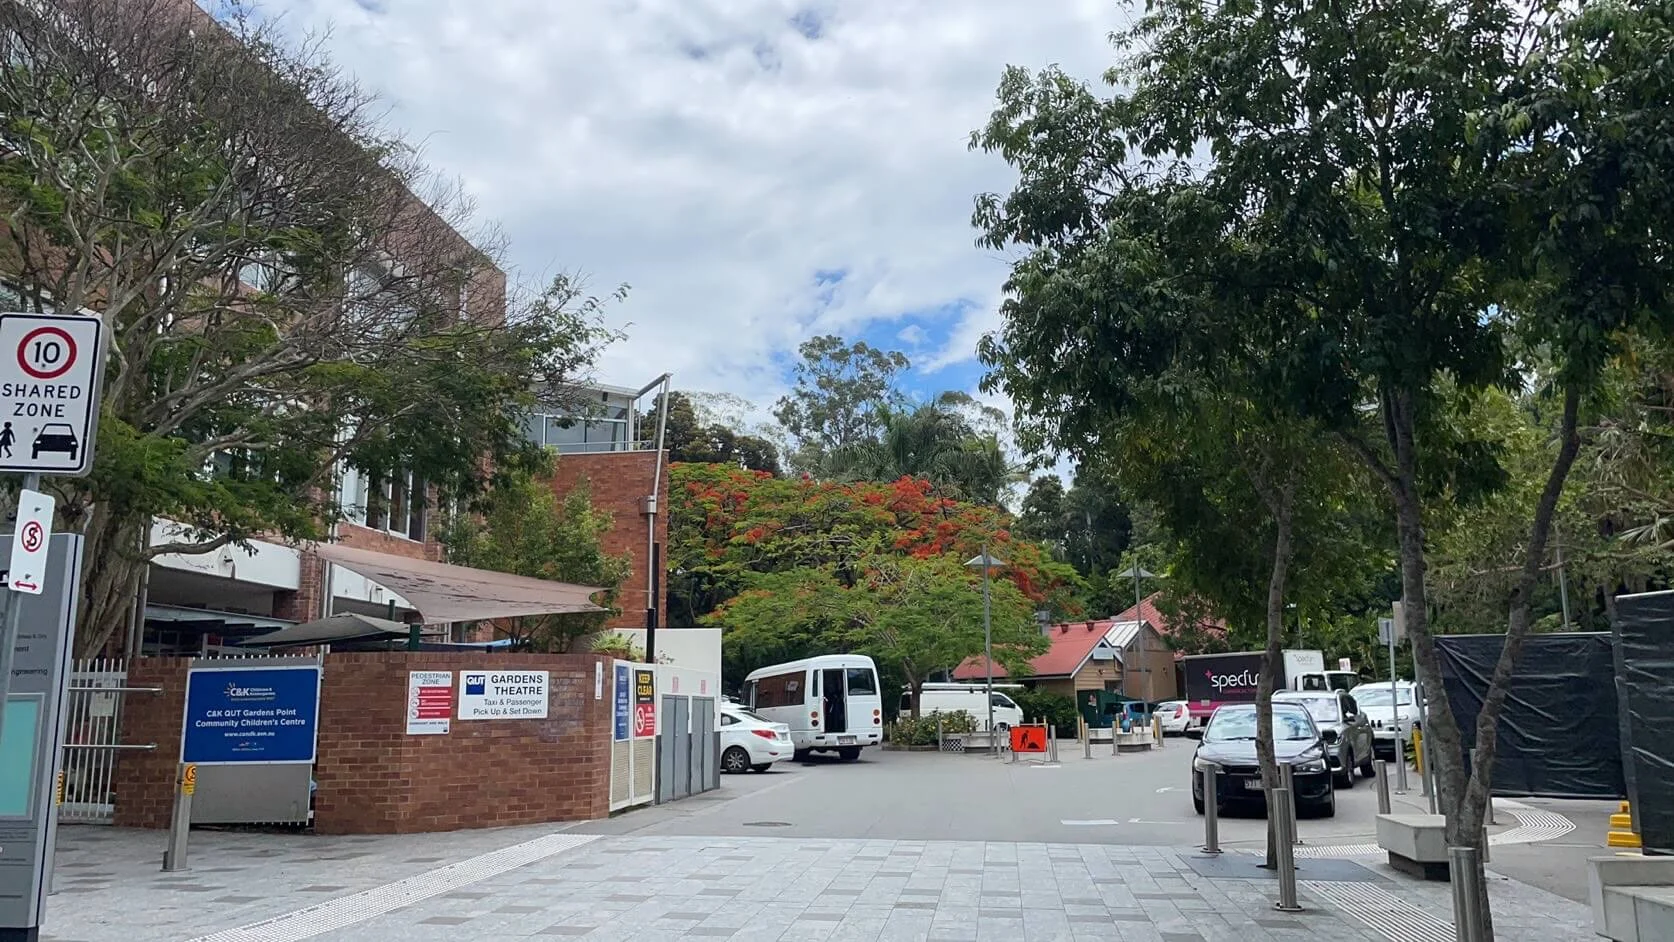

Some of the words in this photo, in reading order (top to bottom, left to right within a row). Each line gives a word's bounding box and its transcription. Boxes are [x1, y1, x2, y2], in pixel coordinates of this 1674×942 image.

[34, 341, 61, 364] 10
[2, 383, 81, 399] SHARED
[13, 402, 65, 417] ZONE
[467, 676, 485, 686] QUT
[491, 674, 543, 684] GARDENS
[638, 673, 650, 684] KEEP
[1211, 669, 1260, 693] specfur
[494, 686, 543, 695] THEATRE
[637, 685, 653, 696] CLEAR
[506, 698, 542, 707] Passenger
[206, 710, 223, 718] C&K
[224, 709, 241, 717] QUT
[242, 708, 274, 717] Gardens
[276, 708, 297, 716] Point
[490, 708, 500, 716] Up
[195, 720, 239, 728] Community
[240, 719, 279, 727] Children's
[280, 718, 306, 726] Centre
